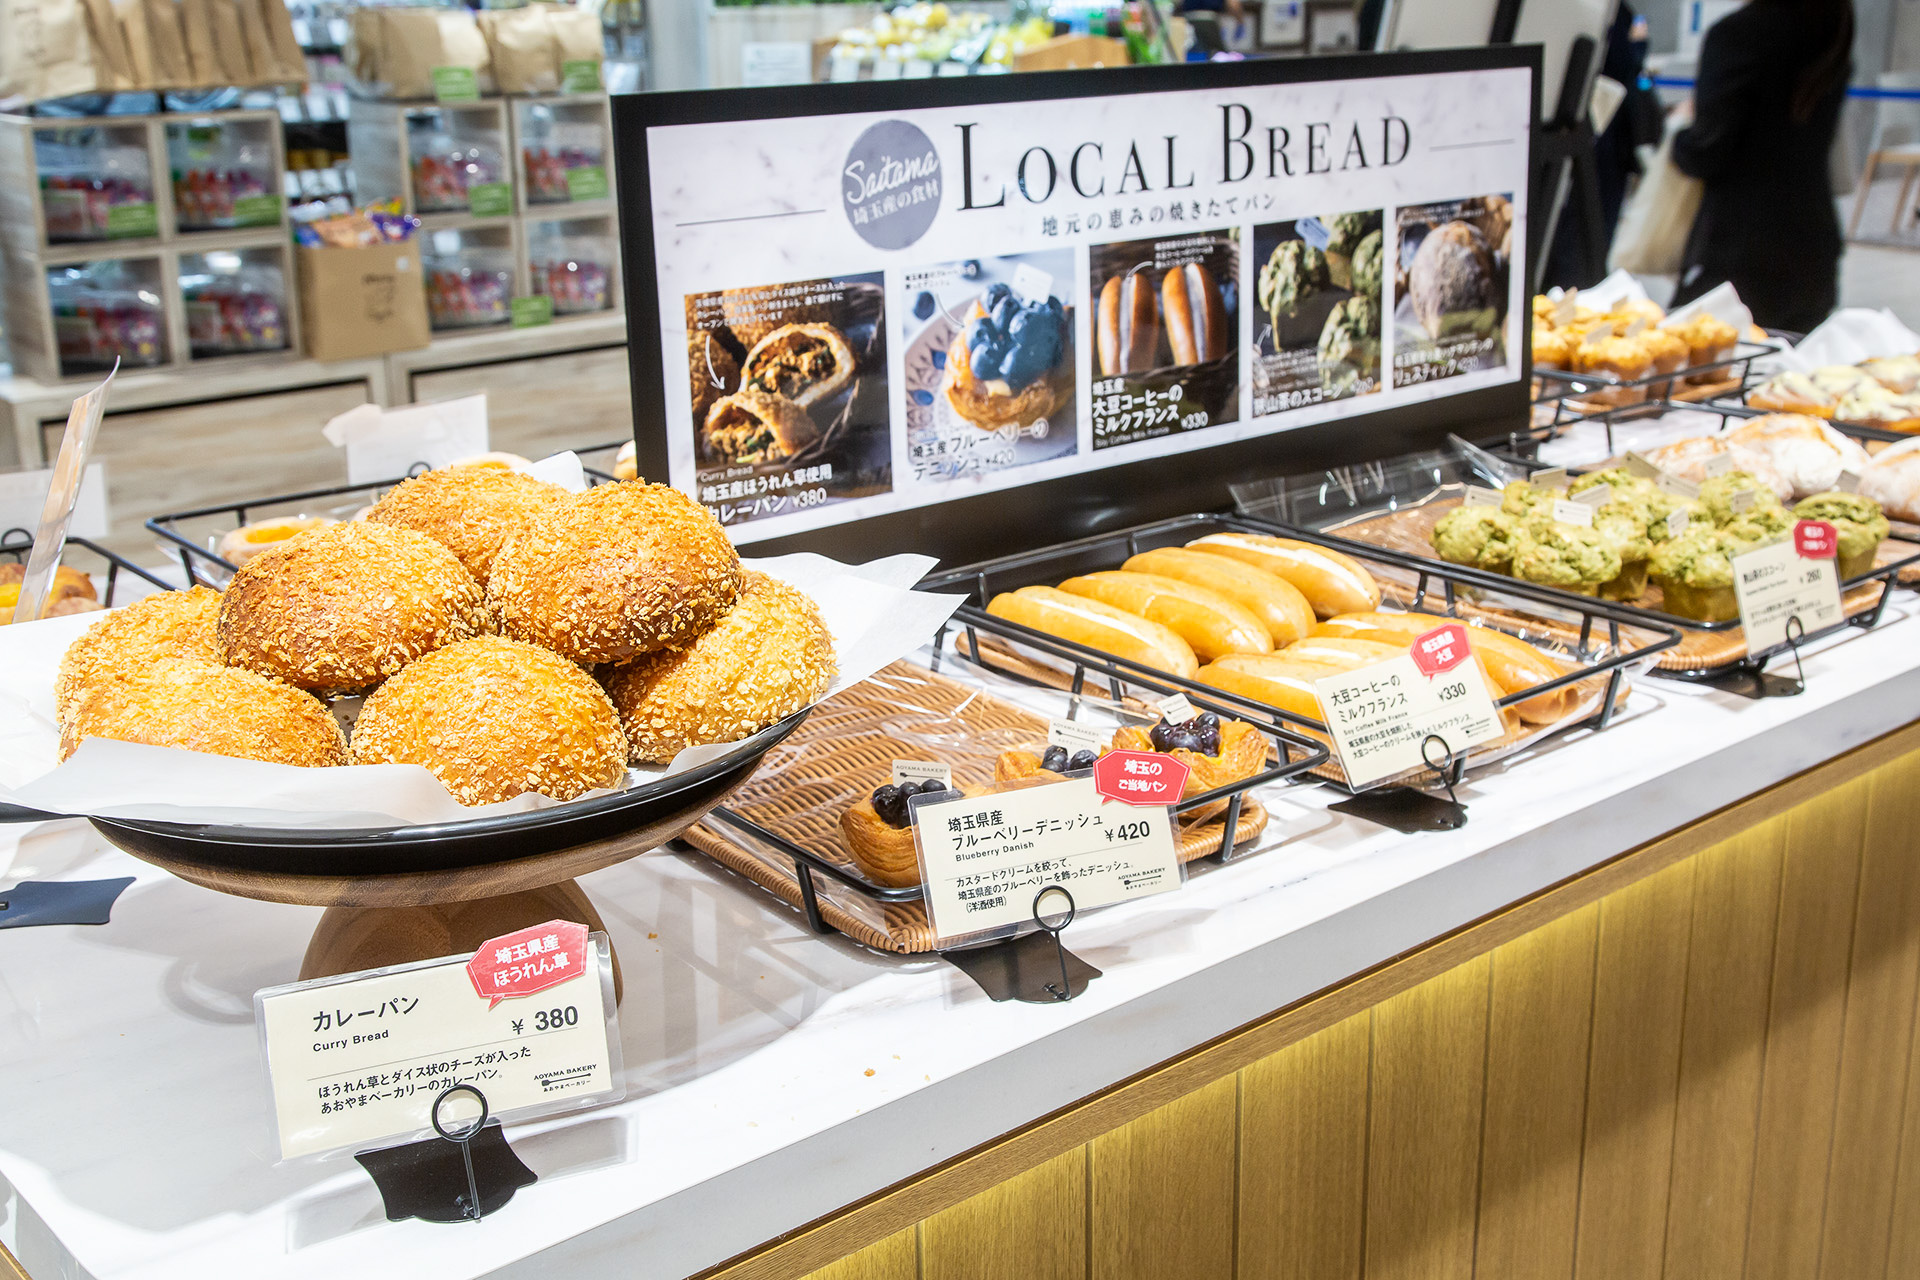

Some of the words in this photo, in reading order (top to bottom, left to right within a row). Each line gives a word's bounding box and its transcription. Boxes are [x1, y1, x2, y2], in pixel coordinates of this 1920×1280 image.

[845, 151, 940, 203] Saitama
[853, 179, 940, 226] 埼玉産の食材
[1041, 192, 1277, 236] 地元の恵みの焼きたてパン
[1092, 384, 1183, 418] 大豆コーヒーの
[1095, 404, 1180, 436] ミルクフランス
[700, 471, 725, 483] Curry
[726, 465, 754, 478] Bread
[701, 463, 833, 503] 埼玉産ほうれん草使用
[791, 487, 827, 508] ¥380
[1421, 630, 1456, 654] 埼玉県産
[1436, 647, 1455, 665] 大豆
[1331, 674, 1401, 707] 大豆コーヒーの
[1338, 692, 1409, 723] ミルクフランス
[1124, 759, 1163, 776] 埼玉の
[1118, 778, 1168, 793] ご当地パン
[947, 810, 1004, 833] 埼玉県産
[951, 813, 1103, 851] ブルーベリーデニッシュ
[955, 847, 1000, 862] Blueberry
[1003, 840, 1035, 853] Danish
[494, 933, 561, 965] 埼玉県産
[493, 952, 571, 987] ほうれん草
[312, 995, 420, 1033] カレーパン
[313, 1039, 348, 1052] Curry
[352, 1029, 390, 1045] Bread
[318, 1046, 532, 1099] ほうれん草とダイス状のチーズが入った
[533, 1070, 565, 1081] AOYAMA
[566, 1063, 598, 1075] BAKERY
